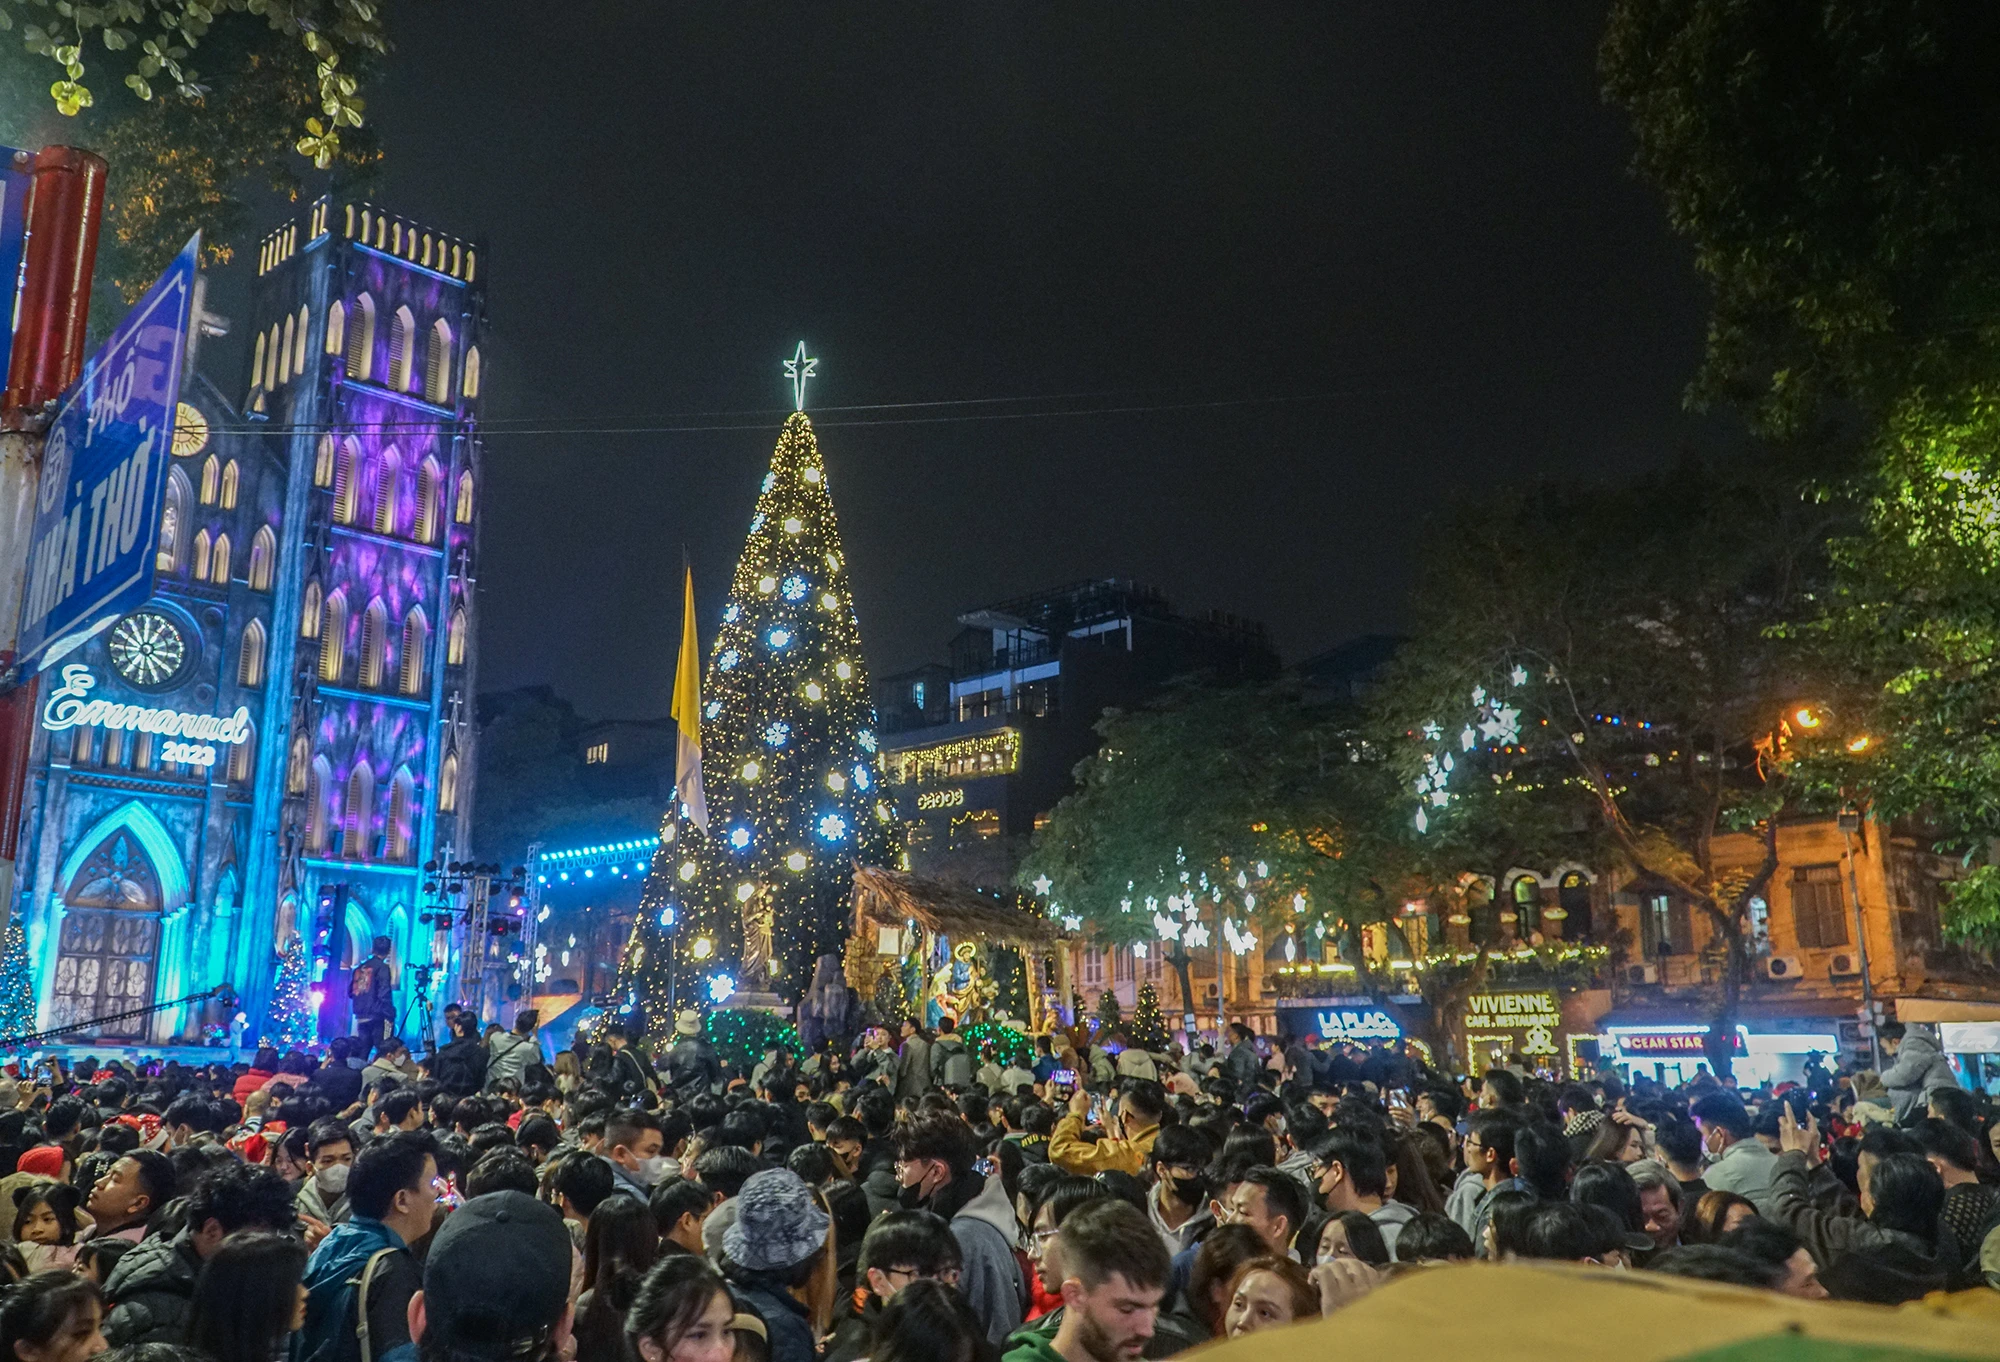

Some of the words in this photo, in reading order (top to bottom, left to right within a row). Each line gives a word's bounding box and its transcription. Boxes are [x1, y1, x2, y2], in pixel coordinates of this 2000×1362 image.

[85, 328, 143, 448] PHỐ
[24, 480, 82, 631] NHÀ
[83, 416, 155, 585] THỜ
[42, 664, 249, 744] Emmanuel
[160, 741, 216, 766] 2023
[1469, 994, 1555, 1013] VIVIENNE
[1318, 1012, 1343, 1029] LA
[1669, 1036, 1704, 1048] STAR
